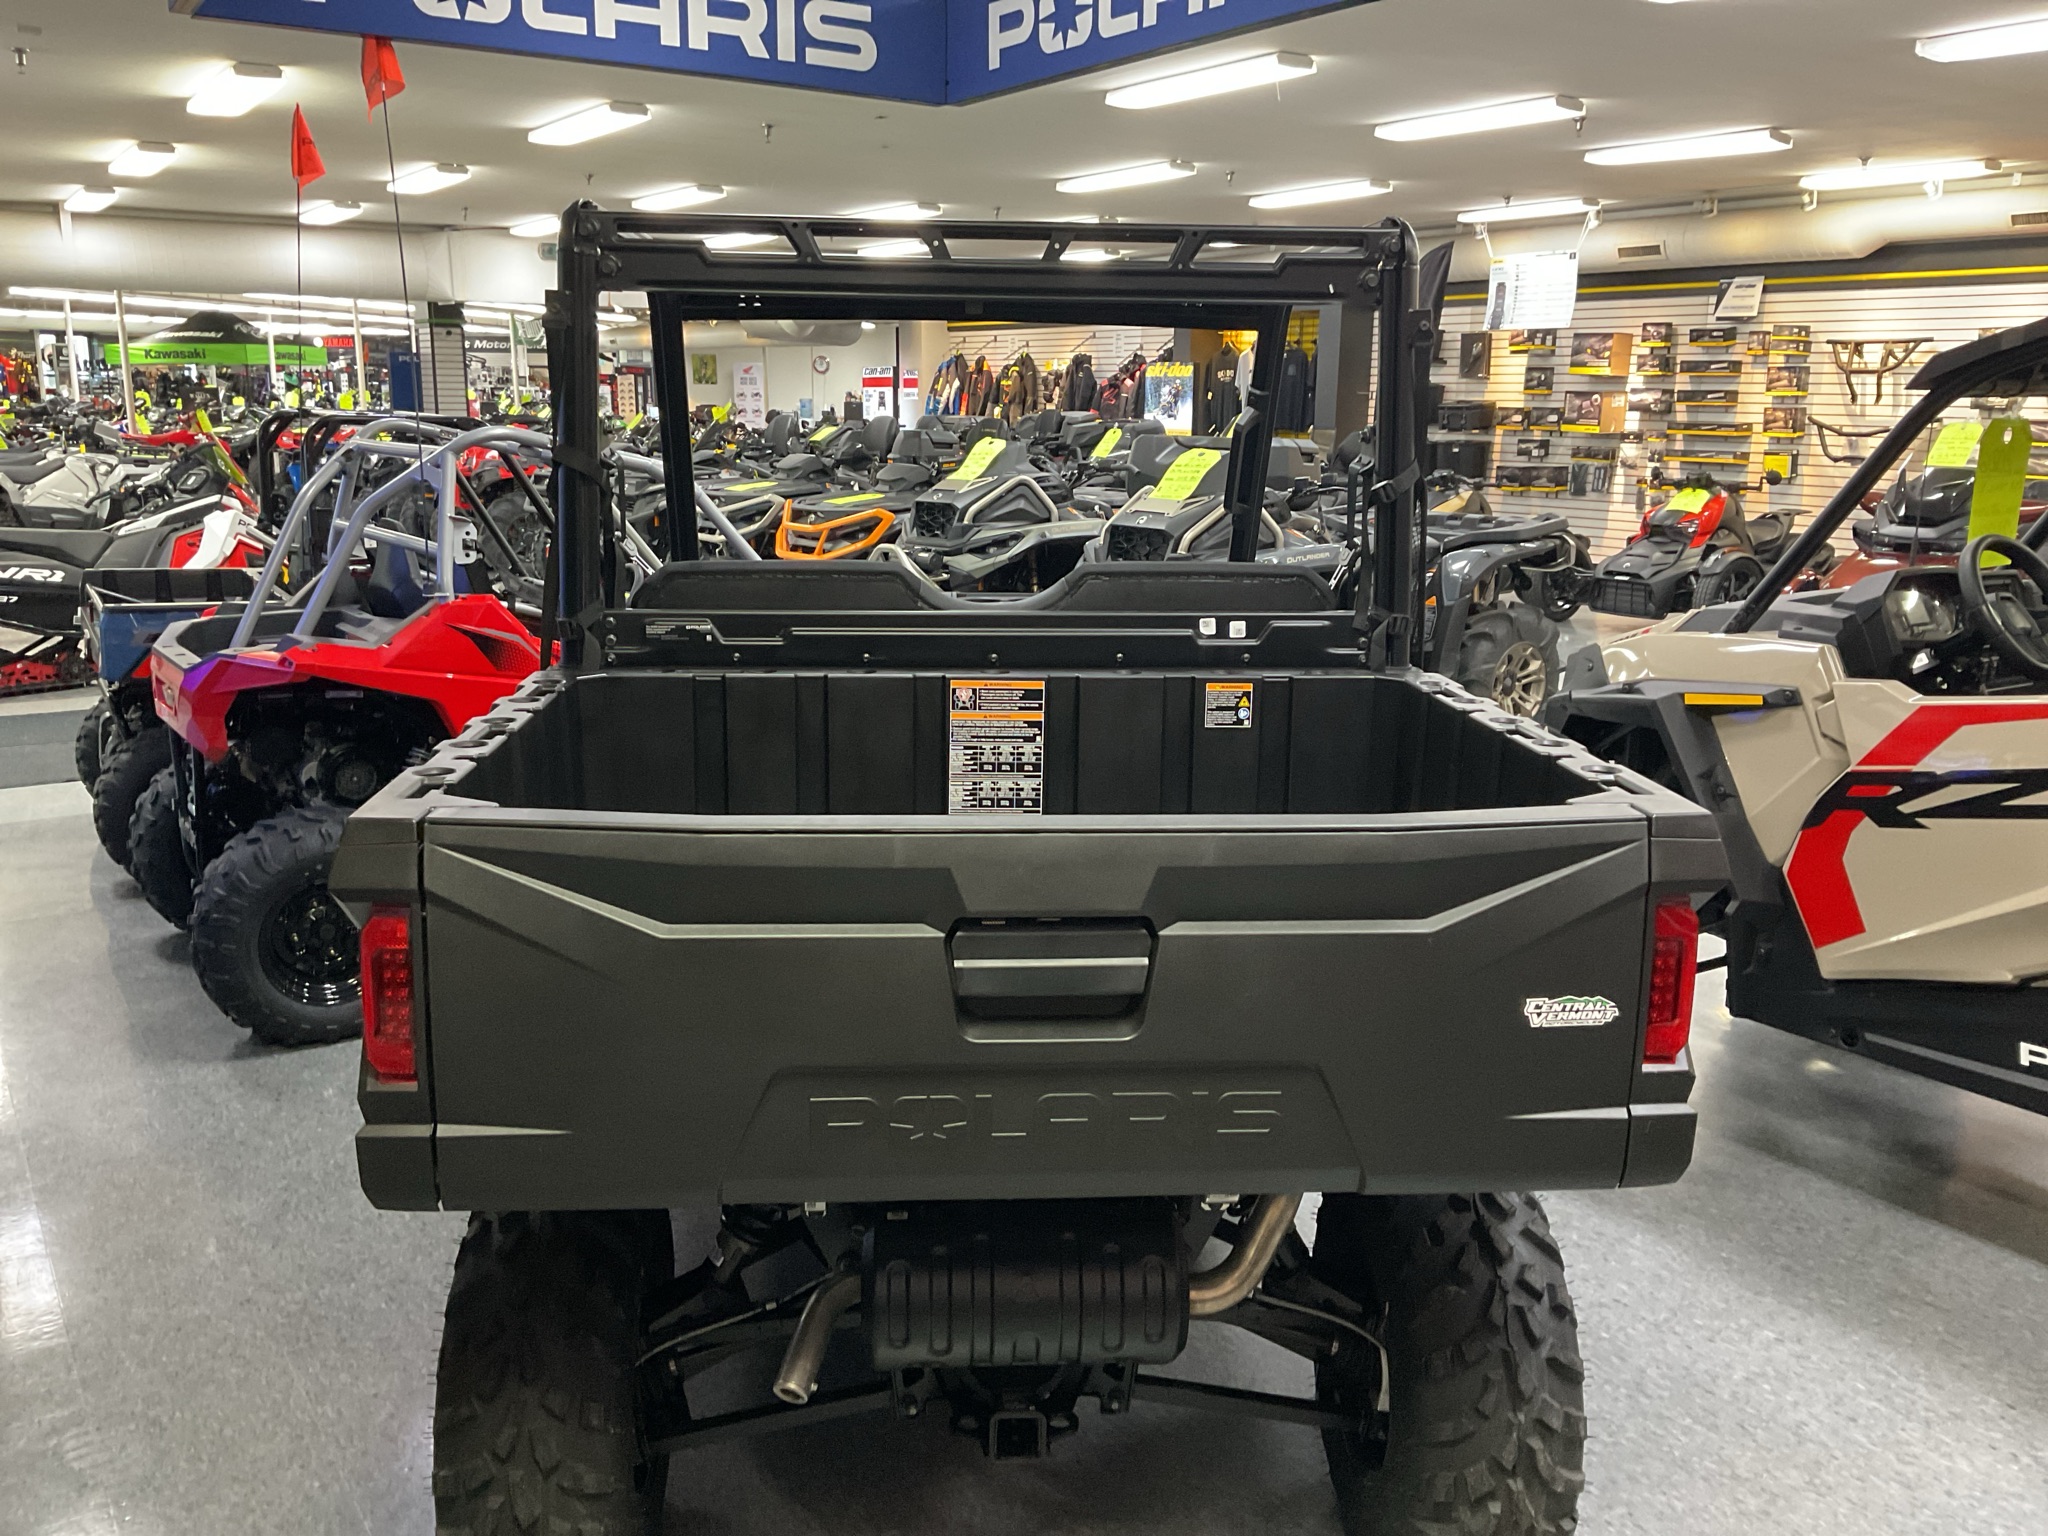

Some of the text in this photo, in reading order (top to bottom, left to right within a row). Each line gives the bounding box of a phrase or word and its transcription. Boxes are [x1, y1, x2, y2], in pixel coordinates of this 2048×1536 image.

[306, 0, 878, 72] LARIS
[323, 336, 354, 348] YAMAHA
[144, 349, 207, 360] Kawasaki
[275, 350, 307, 361] awasaki
[864, 367, 891, 376] can-am
[1145, 362, 1194, 377] ski-doo
[1286, 552, 1330, 564] OUTLANDER
[1526, 1001, 1608, 1013] CENTRAL
[1531, 1010, 1615, 1025] VERMONT
[809, 1090, 1284, 1140] POLARIS
